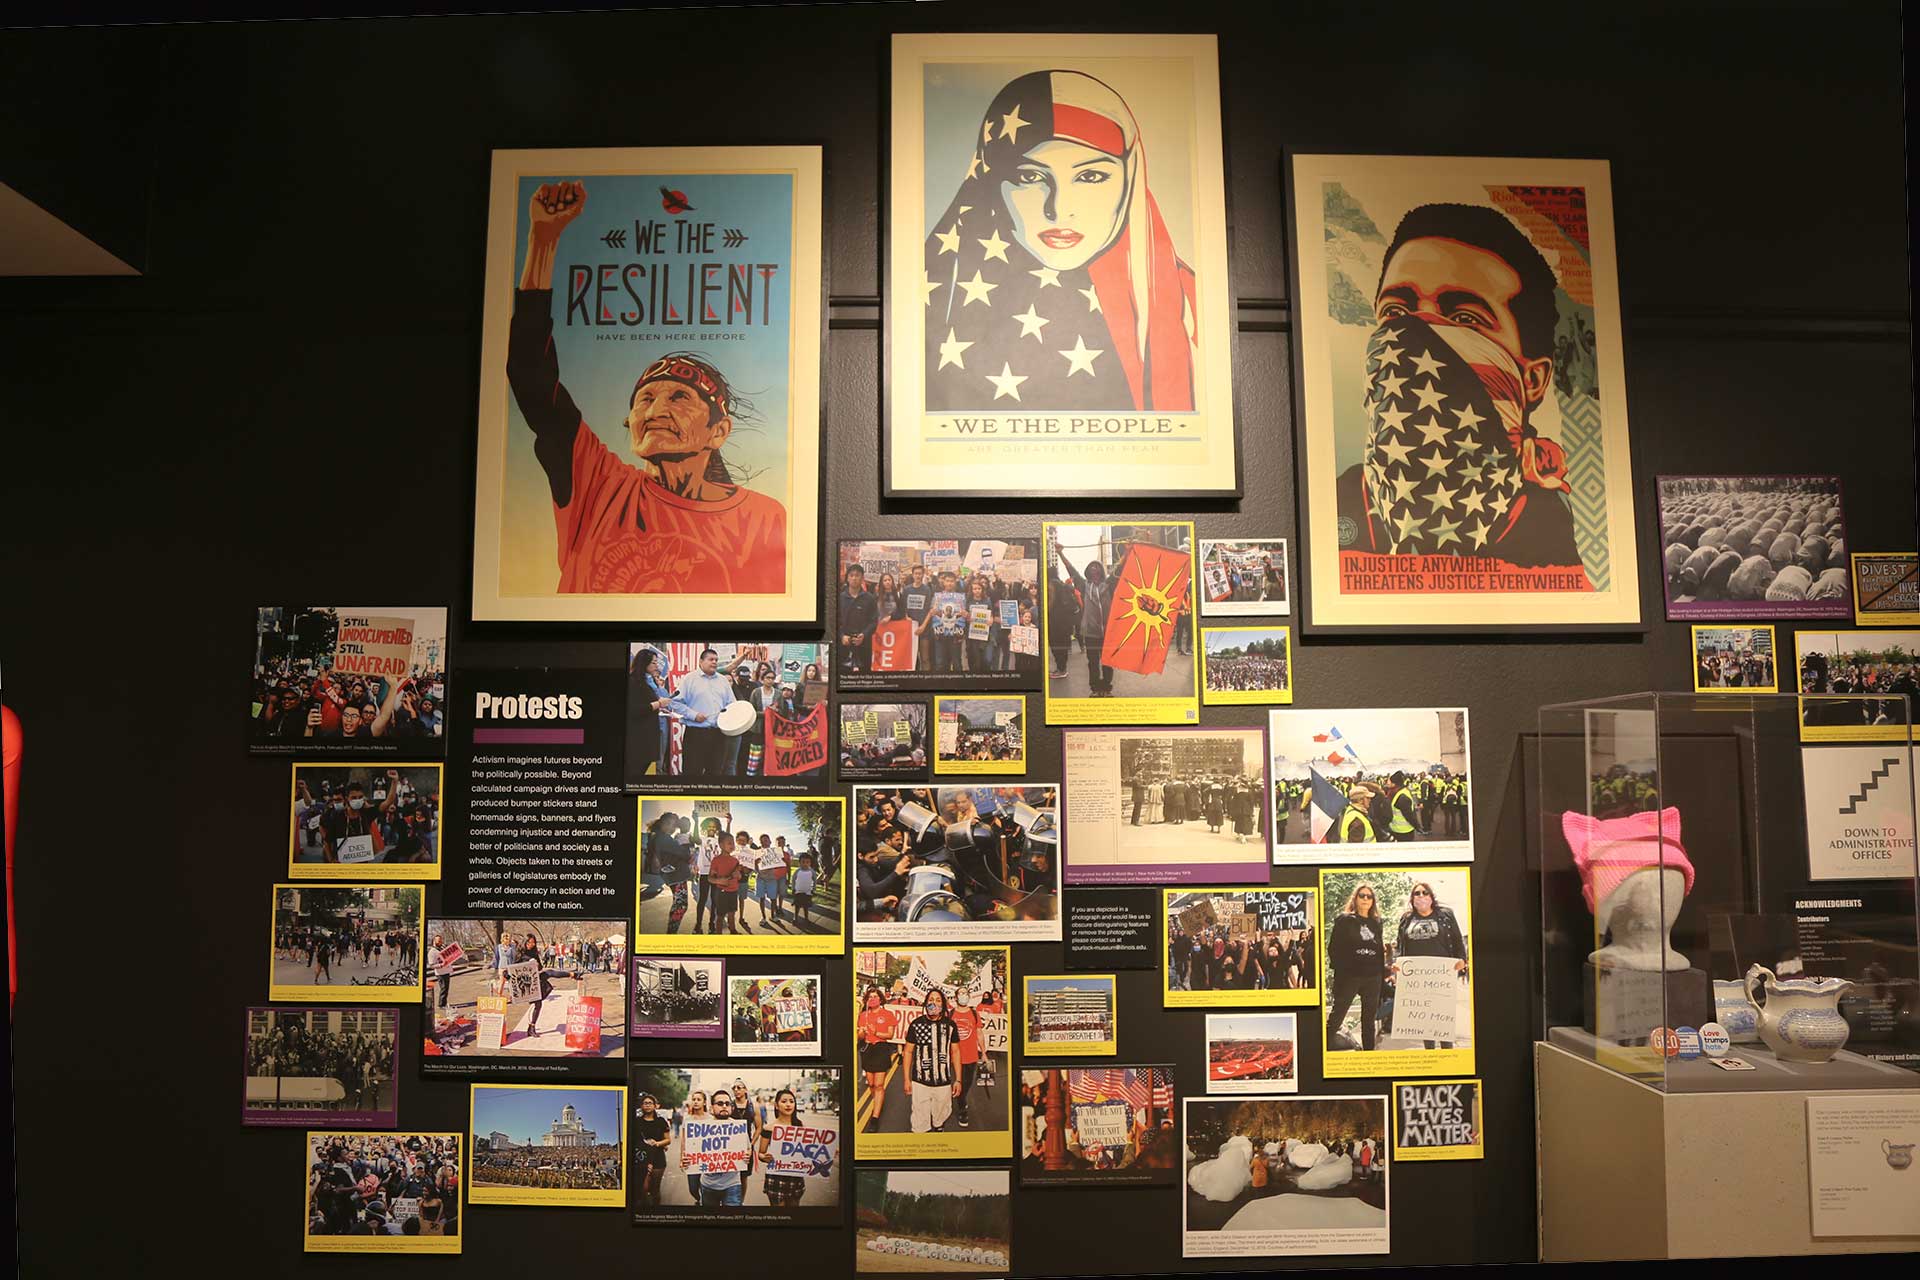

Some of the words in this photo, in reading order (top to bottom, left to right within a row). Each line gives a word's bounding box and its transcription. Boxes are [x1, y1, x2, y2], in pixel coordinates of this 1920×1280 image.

[635, 220, 666, 254] WE
[674, 220, 715, 254] THE
[567, 264, 778, 326] RESILIENT
[954, 419, 998, 434] WE
[1007, 418, 1060, 434] THE
[1071, 418, 1173, 434] PEOPLE
[1344, 557, 1417, 572] INJUSTICE
[1422, 557, 1501, 572] ANYWHERE
[1862, 564, 1907, 575] DIVEST
[1344, 574, 1424, 590] THREATENS
[1428, 574, 1484, 590] JUSTICE
[1489, 574, 1583, 590] EVERYWHERE
[344, 618, 369, 627] STILL
[339, 628, 413, 645] UNDOCUMENTED
[340, 644, 364, 654] STILL
[336, 655, 405, 675] UNAFRAID
[476, 692, 583, 720] Protests
[472, 755, 505, 764] Activism
[507, 756, 542, 766] imagines
[544, 755, 571, 764] futures
[572, 756, 602, 766] beyond
[472, 770, 484, 778] the
[486, 770, 523, 780] politically
[524, 770, 560, 780] possible.
[561, 770, 592, 780] Beyond
[471, 784, 512, 793] calculated
[513, 784, 553, 795] campaign
[554, 784, 579, 793] drives
[580, 785, 596, 793] and
[471, 799, 509, 808] produced
[510, 799, 541, 809] bumper
[542, 799, 574, 808] stickers
[575, 799, 598, 808] stand
[470, 813, 514, 822] homemade
[516, 813, 539, 824] signs,
[541, 813, 576, 823] banners,
[577, 814, 593, 822] and
[594, 814, 616, 824] flyers
[470, 828, 518, 838] condemning
[520, 828, 553, 838] injustice
[554, 828, 570, 837] and
[571, 828, 616, 839] demanding
[1845, 828, 1879, 838] DOWN
[1882, 828, 1896, 837] TO
[469, 842, 492, 850] better
[494, 842, 502, 850] of
[504, 842, 544, 852] politicians
[544, 842, 560, 851] and
[562, 842, 591, 853] society
[1829, 839, 1914, 849] ADMINISTRATIVE
[1852, 850, 1892, 860] OFFICES
[468, 856, 494, 865] whole.
[496, 856, 527, 867] Objects
[528, 857, 550, 866] taken
[552, 858, 560, 866] to
[561, 857, 575, 866] the
[576, 858, 603, 866] streets
[468, 871, 502, 881] galleries
[503, 871, 511, 880] of
[513, 871, 558, 882] legislatures
[559, 872, 592, 882] embody
[593, 872, 607, 881] the
[468, 886, 492, 895] power
[494, 886, 502, 894] of
[503, 886, 548, 896] democracy
[549, 886, 557, 894] in
[558, 886, 584, 895] action
[584, 887, 601, 895] and
[602, 887, 616, 896] the
[1246, 892, 1279, 905] BLACK
[467, 900, 504, 909] unfiltered
[505, 900, 532, 909] voices
[532, 900, 541, 909] of
[542, 901, 556, 910] the
[557, 901, 584, 910] nation.
[1260, 902, 1288, 914] LIVES
[1263, 911, 1308, 931] MATTER
[1402, 960, 1451, 976] Genocide
[1424, 980, 1452, 988] MORE
[1408, 1011, 1426, 1019] NO
[1401, 1084, 1463, 1110] BLACK
[1404, 1108, 1464, 1126] LIVES
[687, 1123, 746, 1138] EDUCATION
[773, 1126, 836, 1144] DEFEND
[1400, 1123, 1473, 1147] MATTER
[702, 1136, 730, 1152] NOT
[781, 1142, 830, 1159] DACA
